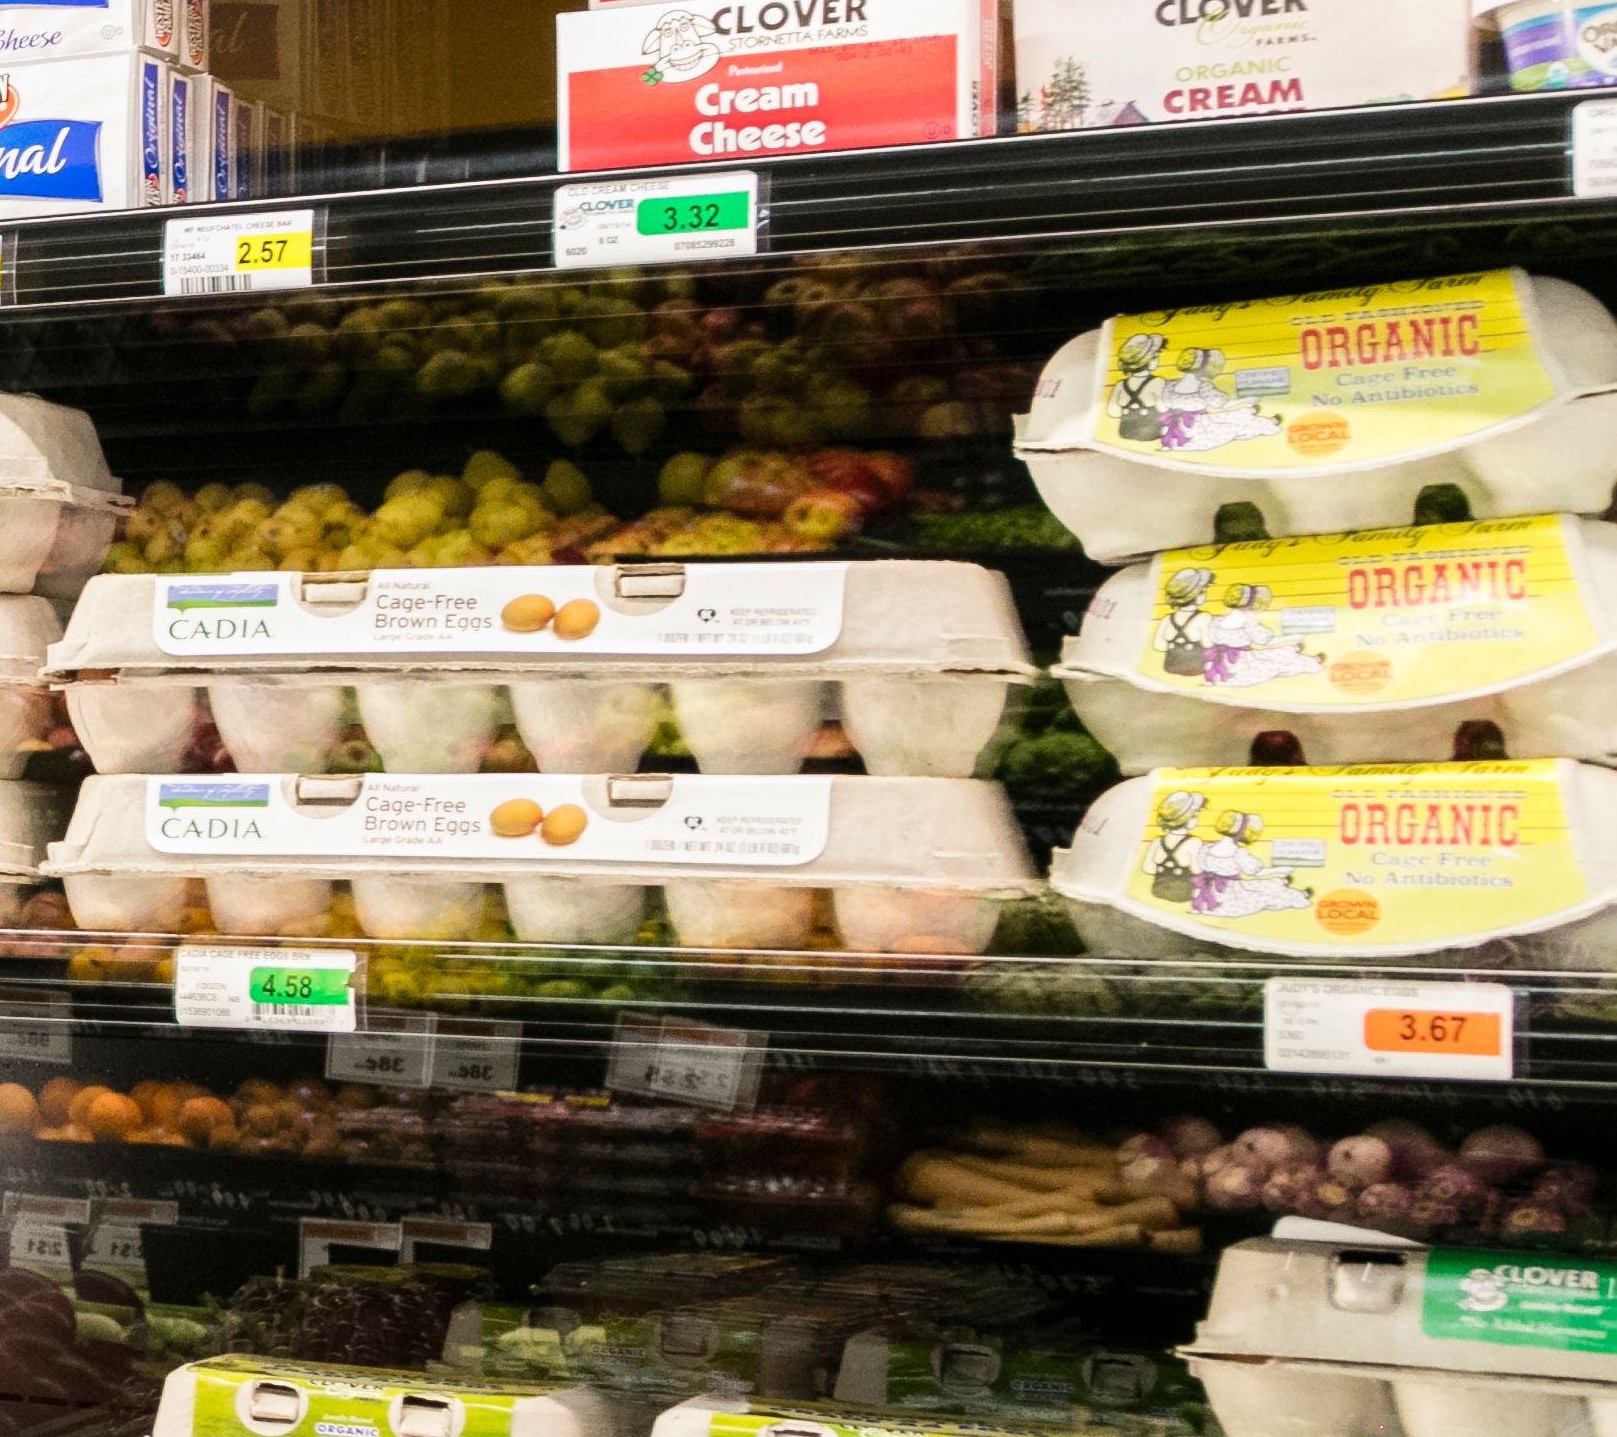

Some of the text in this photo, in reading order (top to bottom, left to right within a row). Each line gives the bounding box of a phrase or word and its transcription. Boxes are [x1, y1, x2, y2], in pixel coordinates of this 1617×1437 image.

[1175, 56, 1292, 82] ORGANIC
[1164, 78, 1304, 114] CREAM
[663, 203, 719, 230] 3.32
[1301, 314, 1480, 370] ORGANIC
[1336, 365, 1457, 387] Cage Free
[1312, 382, 1479, 408] No Antibiotics
[377, 595, 477, 613] Cage-Free
[168, 618, 272, 641] CADIA
[375, 614, 492, 631] Brown Eggs
[261, 974, 312, 999] 4.58
[1400, 1014, 1468, 1042] 3.67
[1494, 1265, 1599, 1290] CLOVER
[317, 1424, 377, 1437] ORGANIC
